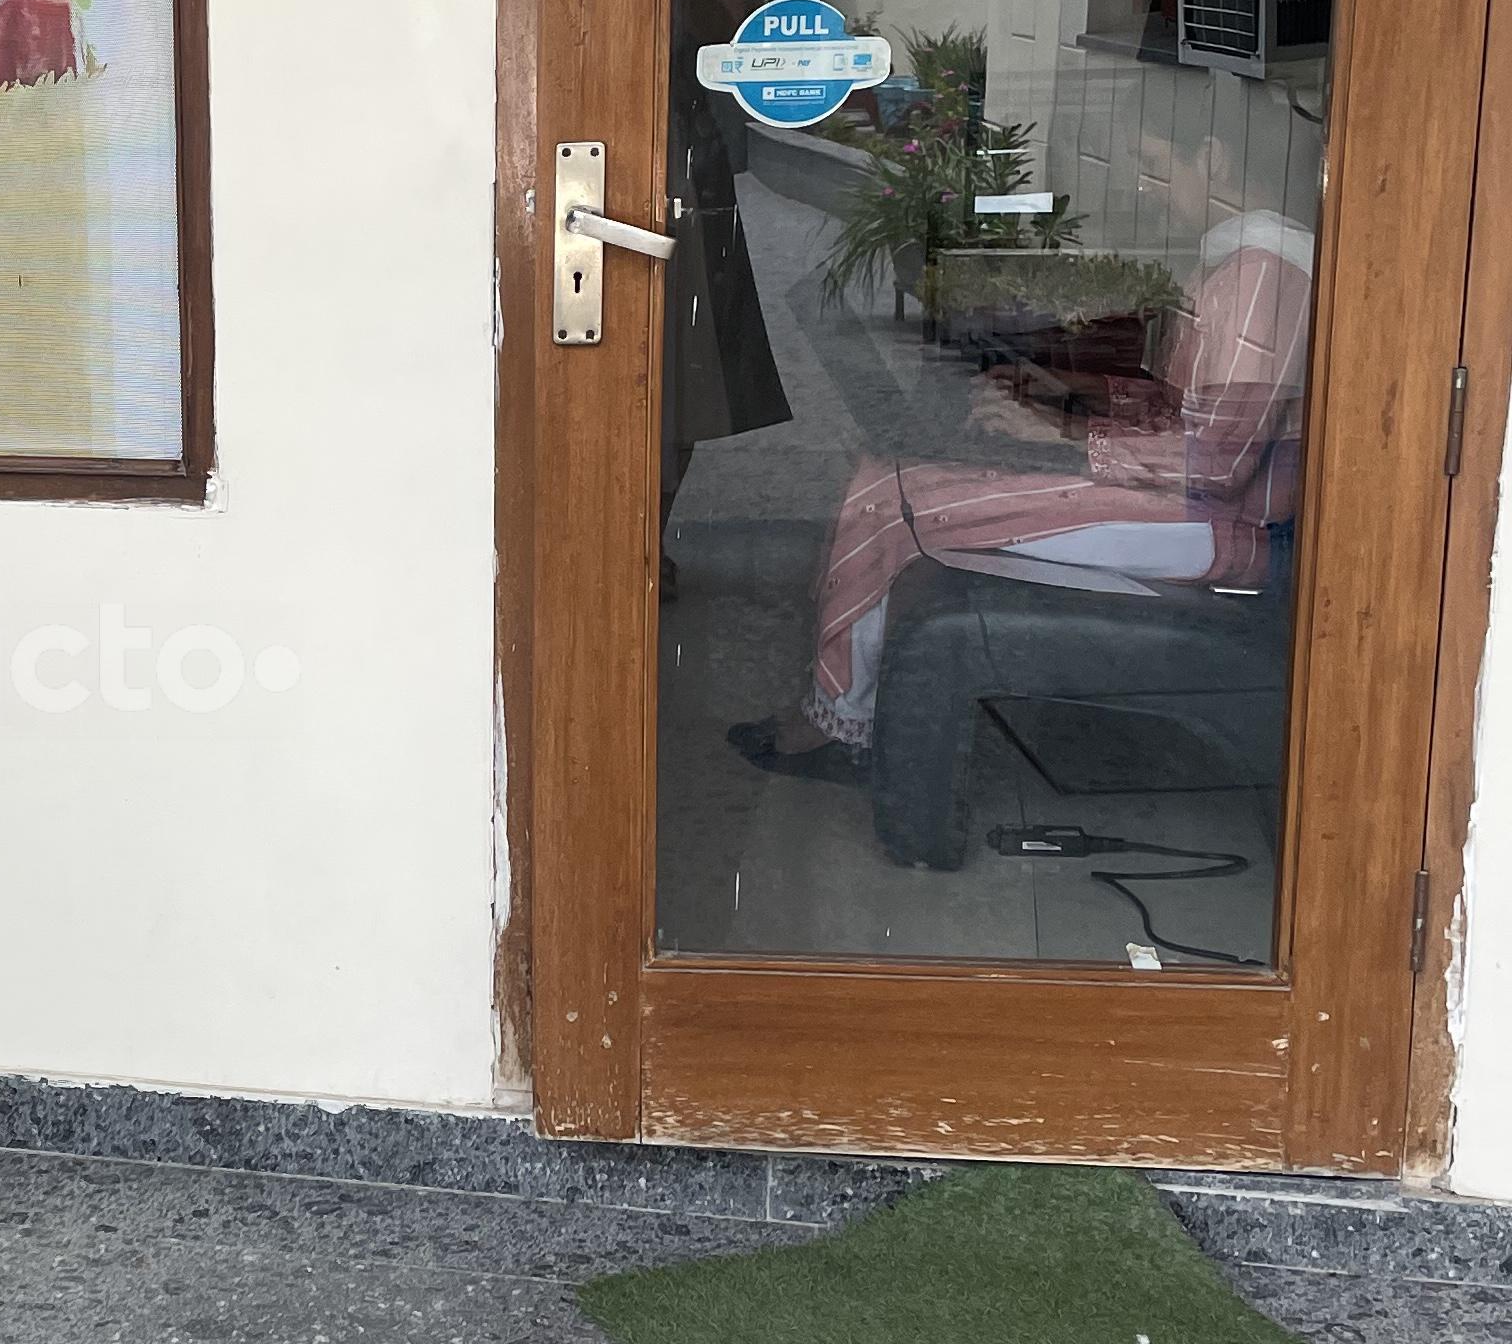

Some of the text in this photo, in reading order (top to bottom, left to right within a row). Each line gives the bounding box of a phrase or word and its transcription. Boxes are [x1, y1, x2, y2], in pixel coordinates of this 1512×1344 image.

[763, 14, 830, 37] PULL
[751, 57, 781, 69] UPI
[799, 88, 822, 97] BANK
